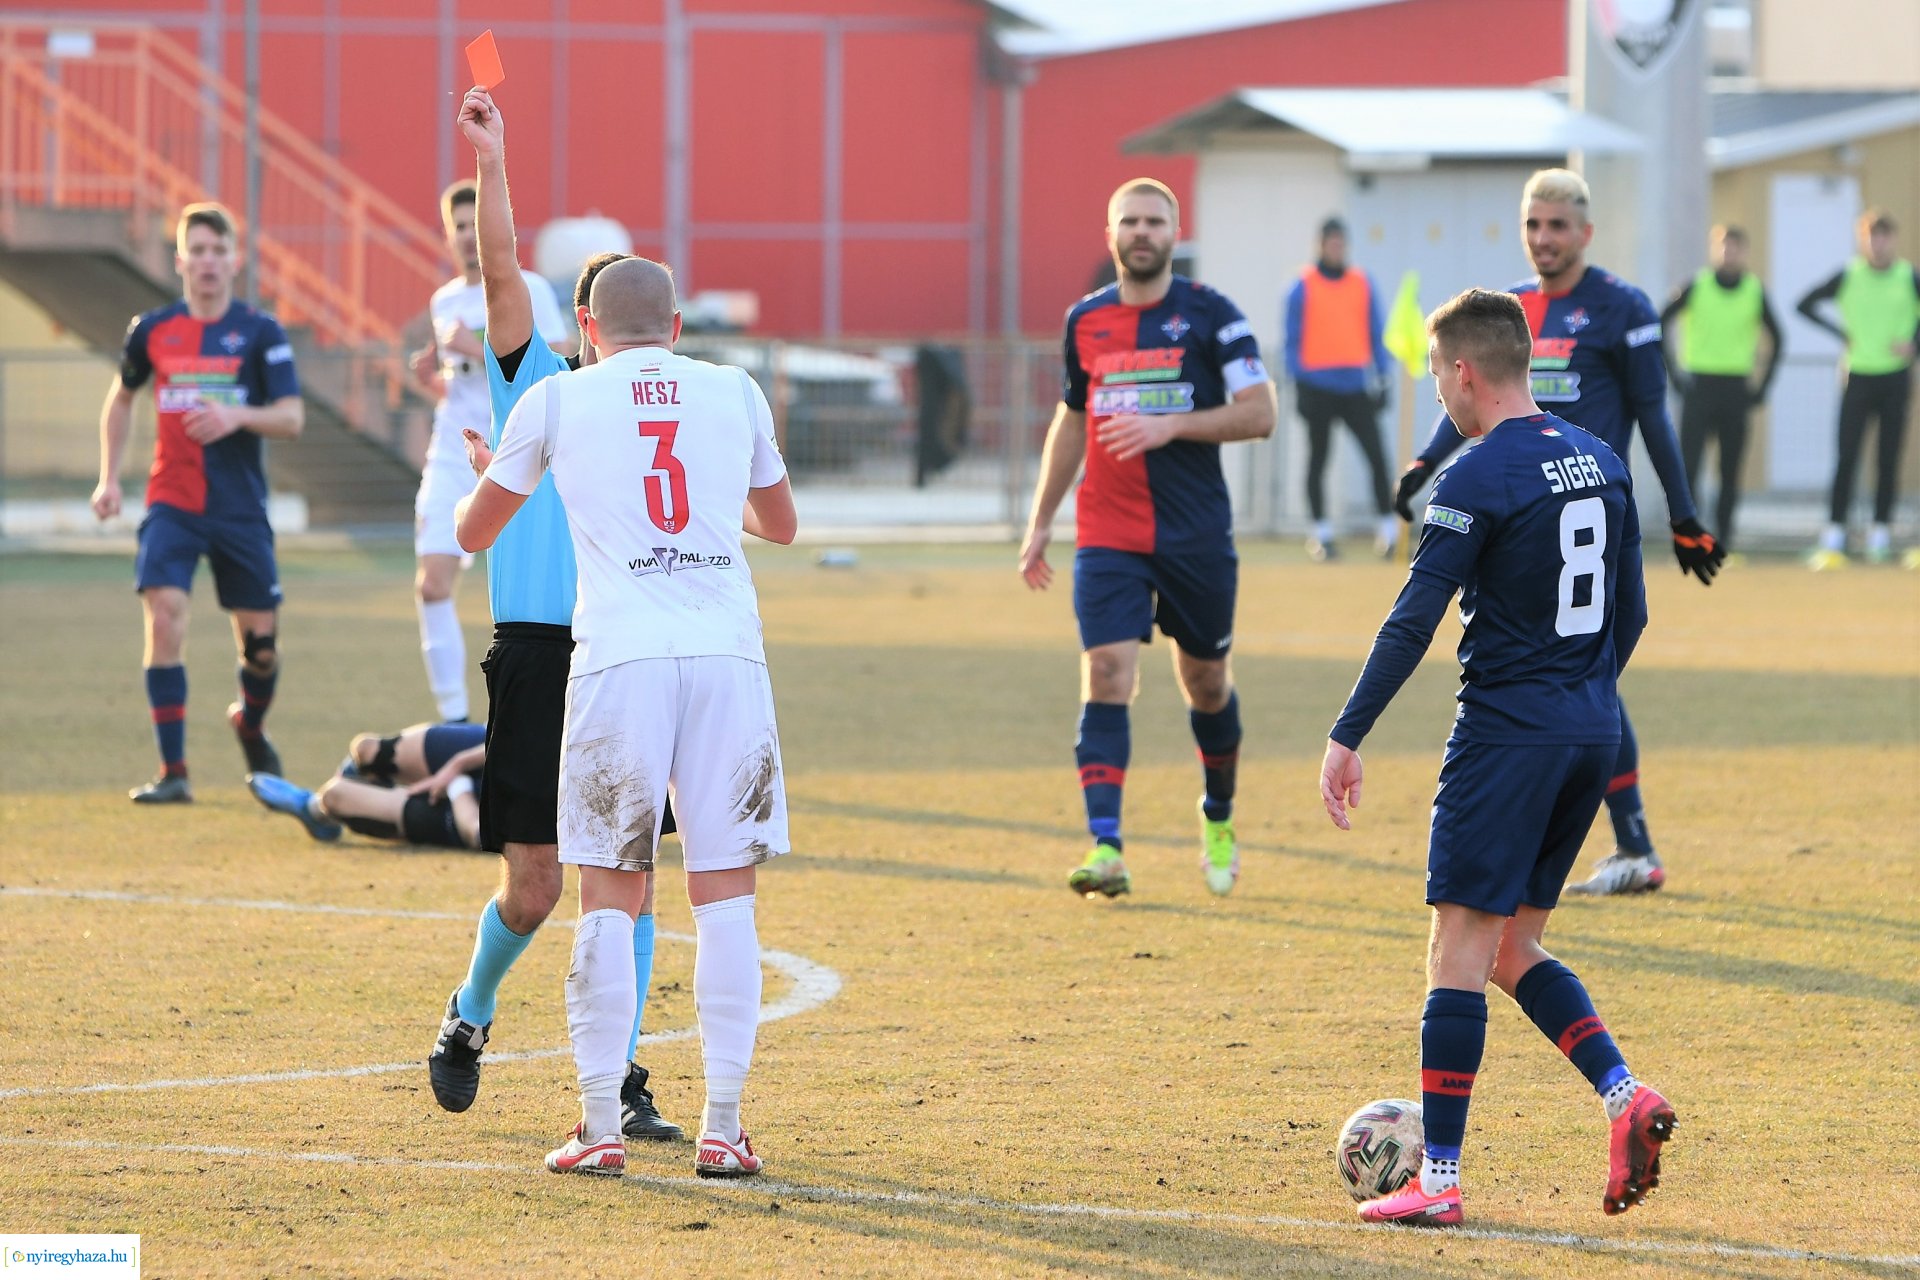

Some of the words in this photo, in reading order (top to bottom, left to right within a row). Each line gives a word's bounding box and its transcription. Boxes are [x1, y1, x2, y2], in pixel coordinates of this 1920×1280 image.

[631, 380, 681, 406] HESZ
[637, 420, 690, 535] 3
[1540, 446, 1608, 494] SIGÉR
[1427, 507, 1469, 530] PMIX
[628, 557, 659, 571] VIVA
[679, 551, 731, 567] PALZZO
[1554, 496, 1607, 638] 8
